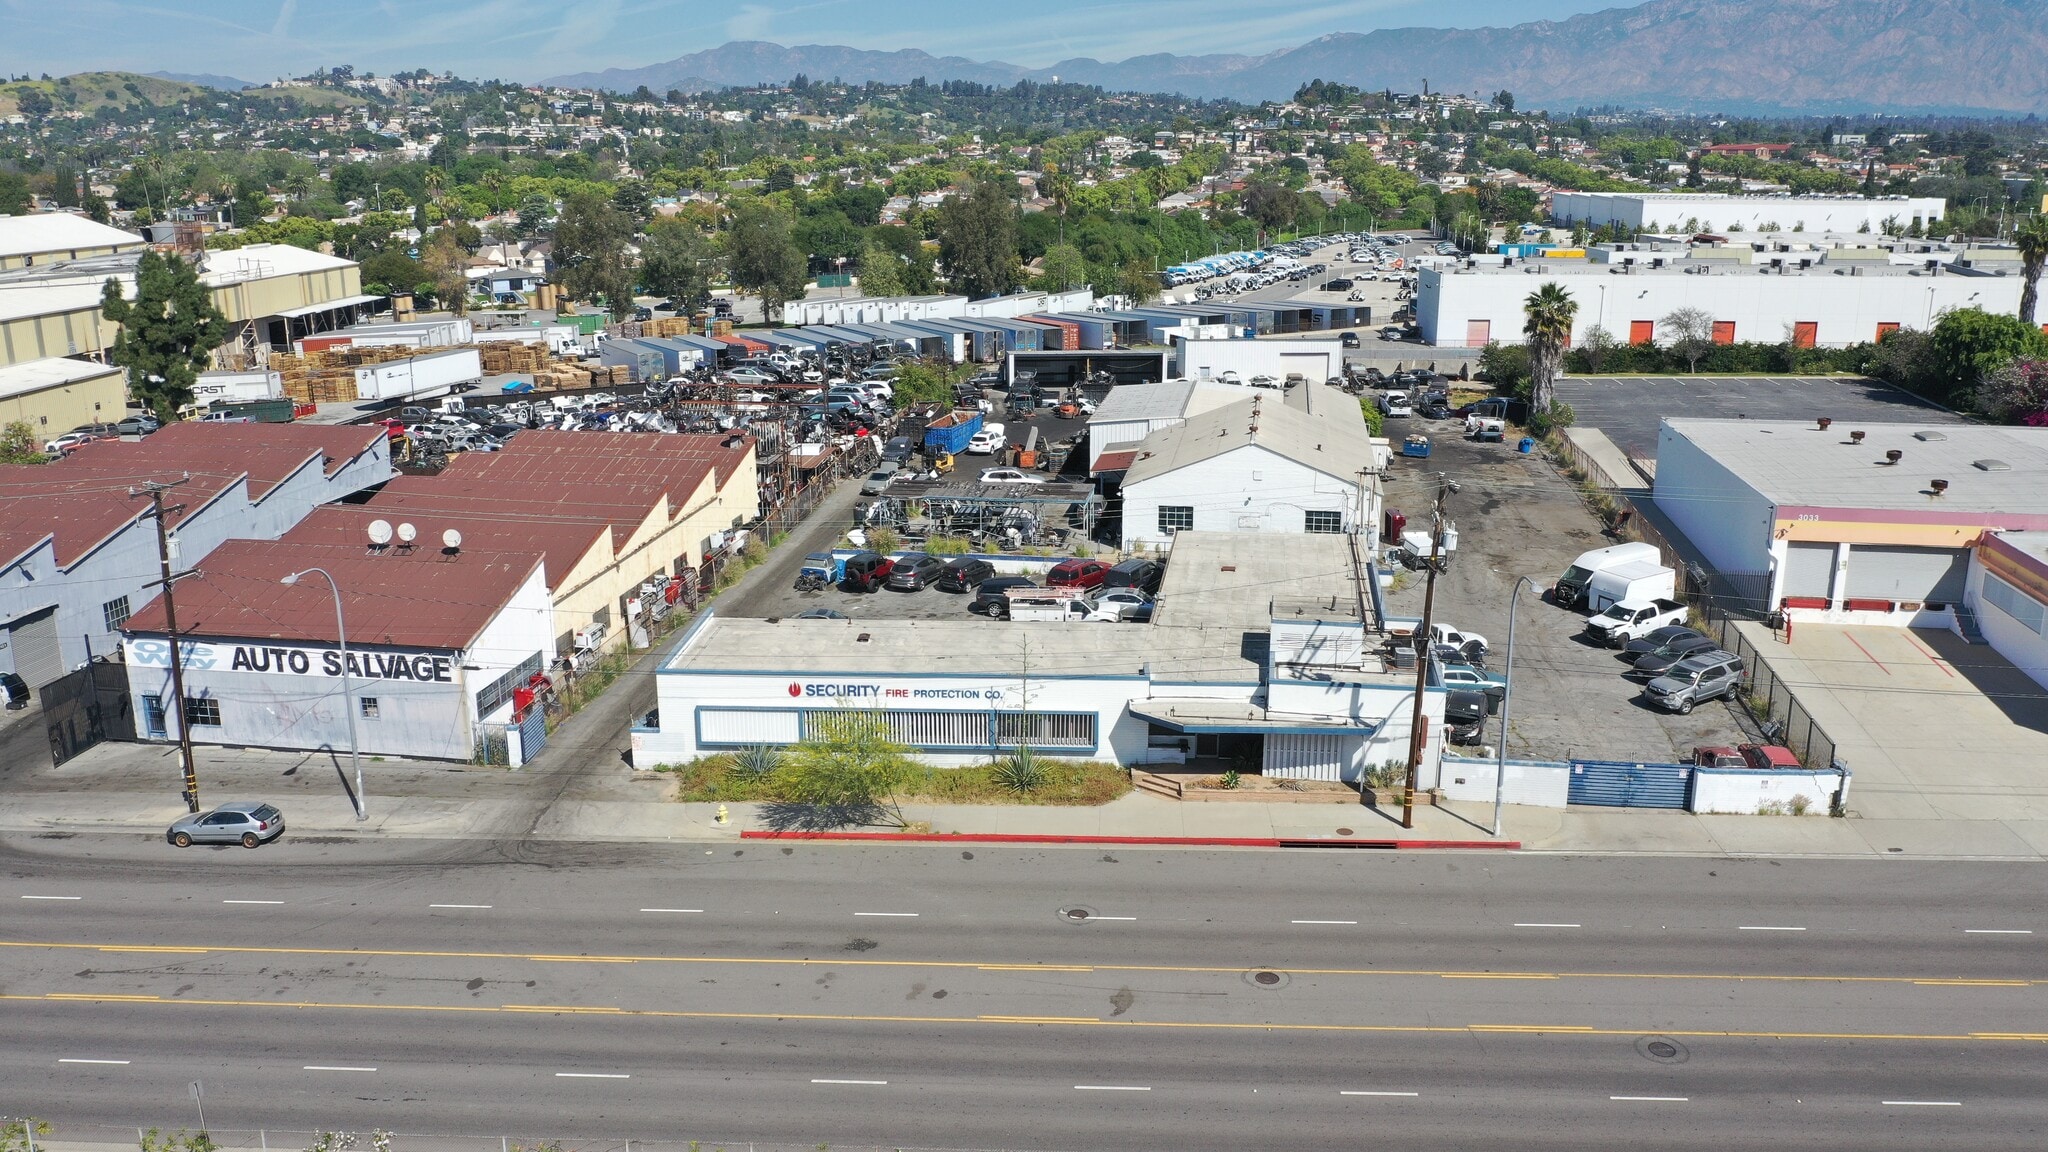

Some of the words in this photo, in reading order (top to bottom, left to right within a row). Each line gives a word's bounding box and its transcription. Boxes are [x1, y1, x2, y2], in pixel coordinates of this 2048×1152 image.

[191, 385, 226, 394] CRST
[232, 646, 310, 674] AUTO
[322, 650, 452, 682] SALVAGE
[805, 684, 880, 697] SECURITY
[885, 689, 909, 698] FIRE
[913, 689, 980, 699] PROTECTION
[984, 690, 1003, 700] CO.
